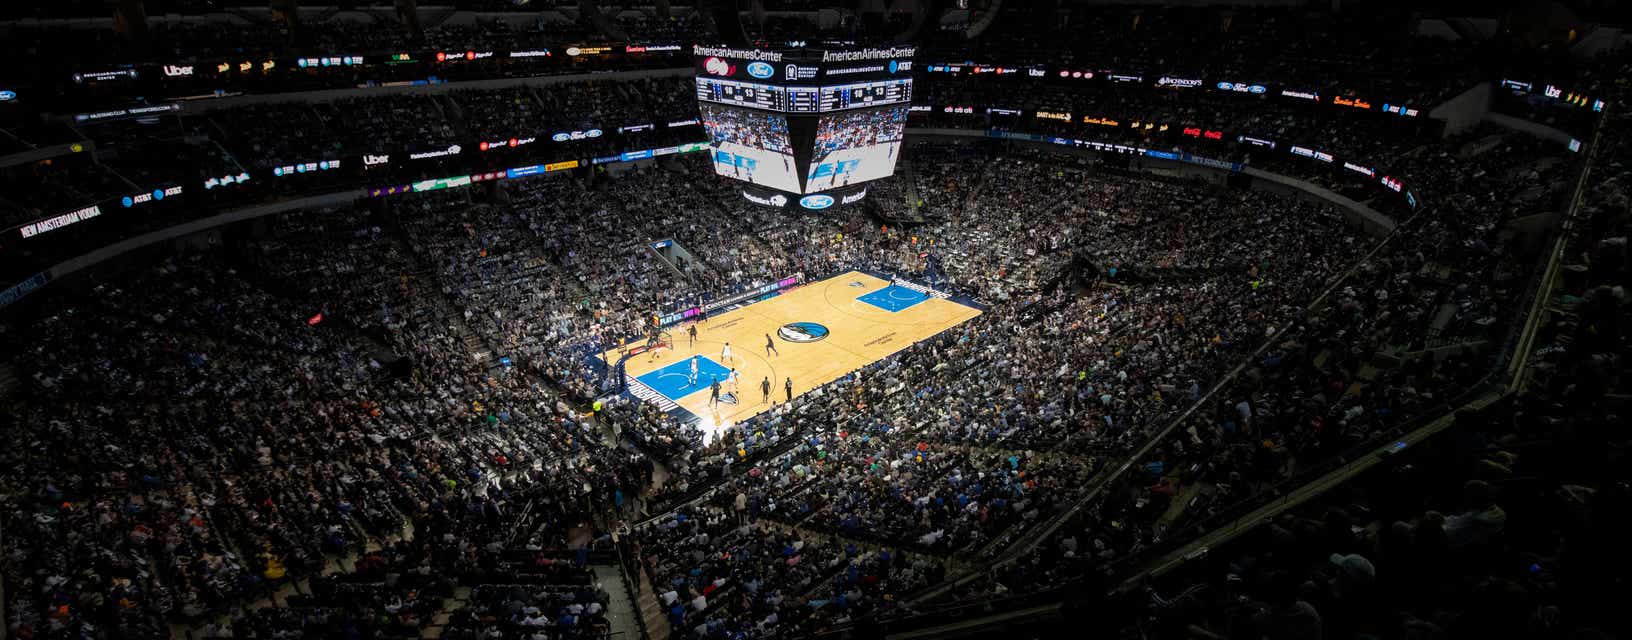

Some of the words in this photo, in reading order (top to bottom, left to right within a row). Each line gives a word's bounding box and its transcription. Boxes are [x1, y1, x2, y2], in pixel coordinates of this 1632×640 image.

[823, 47, 915, 62] AmericanAirlinesCenter
[163, 65, 194, 77] Uber
[897, 62, 912, 71] AT&T
[1029, 68, 1046, 77] Uber
[1545, 84, 1562, 98] Uber
[363, 155, 389, 165] Uber
[165, 187, 182, 197] AT&T
[134, 193, 152, 204] AT&T
[20, 224, 38, 239] NEW
[37, 211, 80, 234] AMSTERDAM
[77, 205, 101, 221] VODKA
